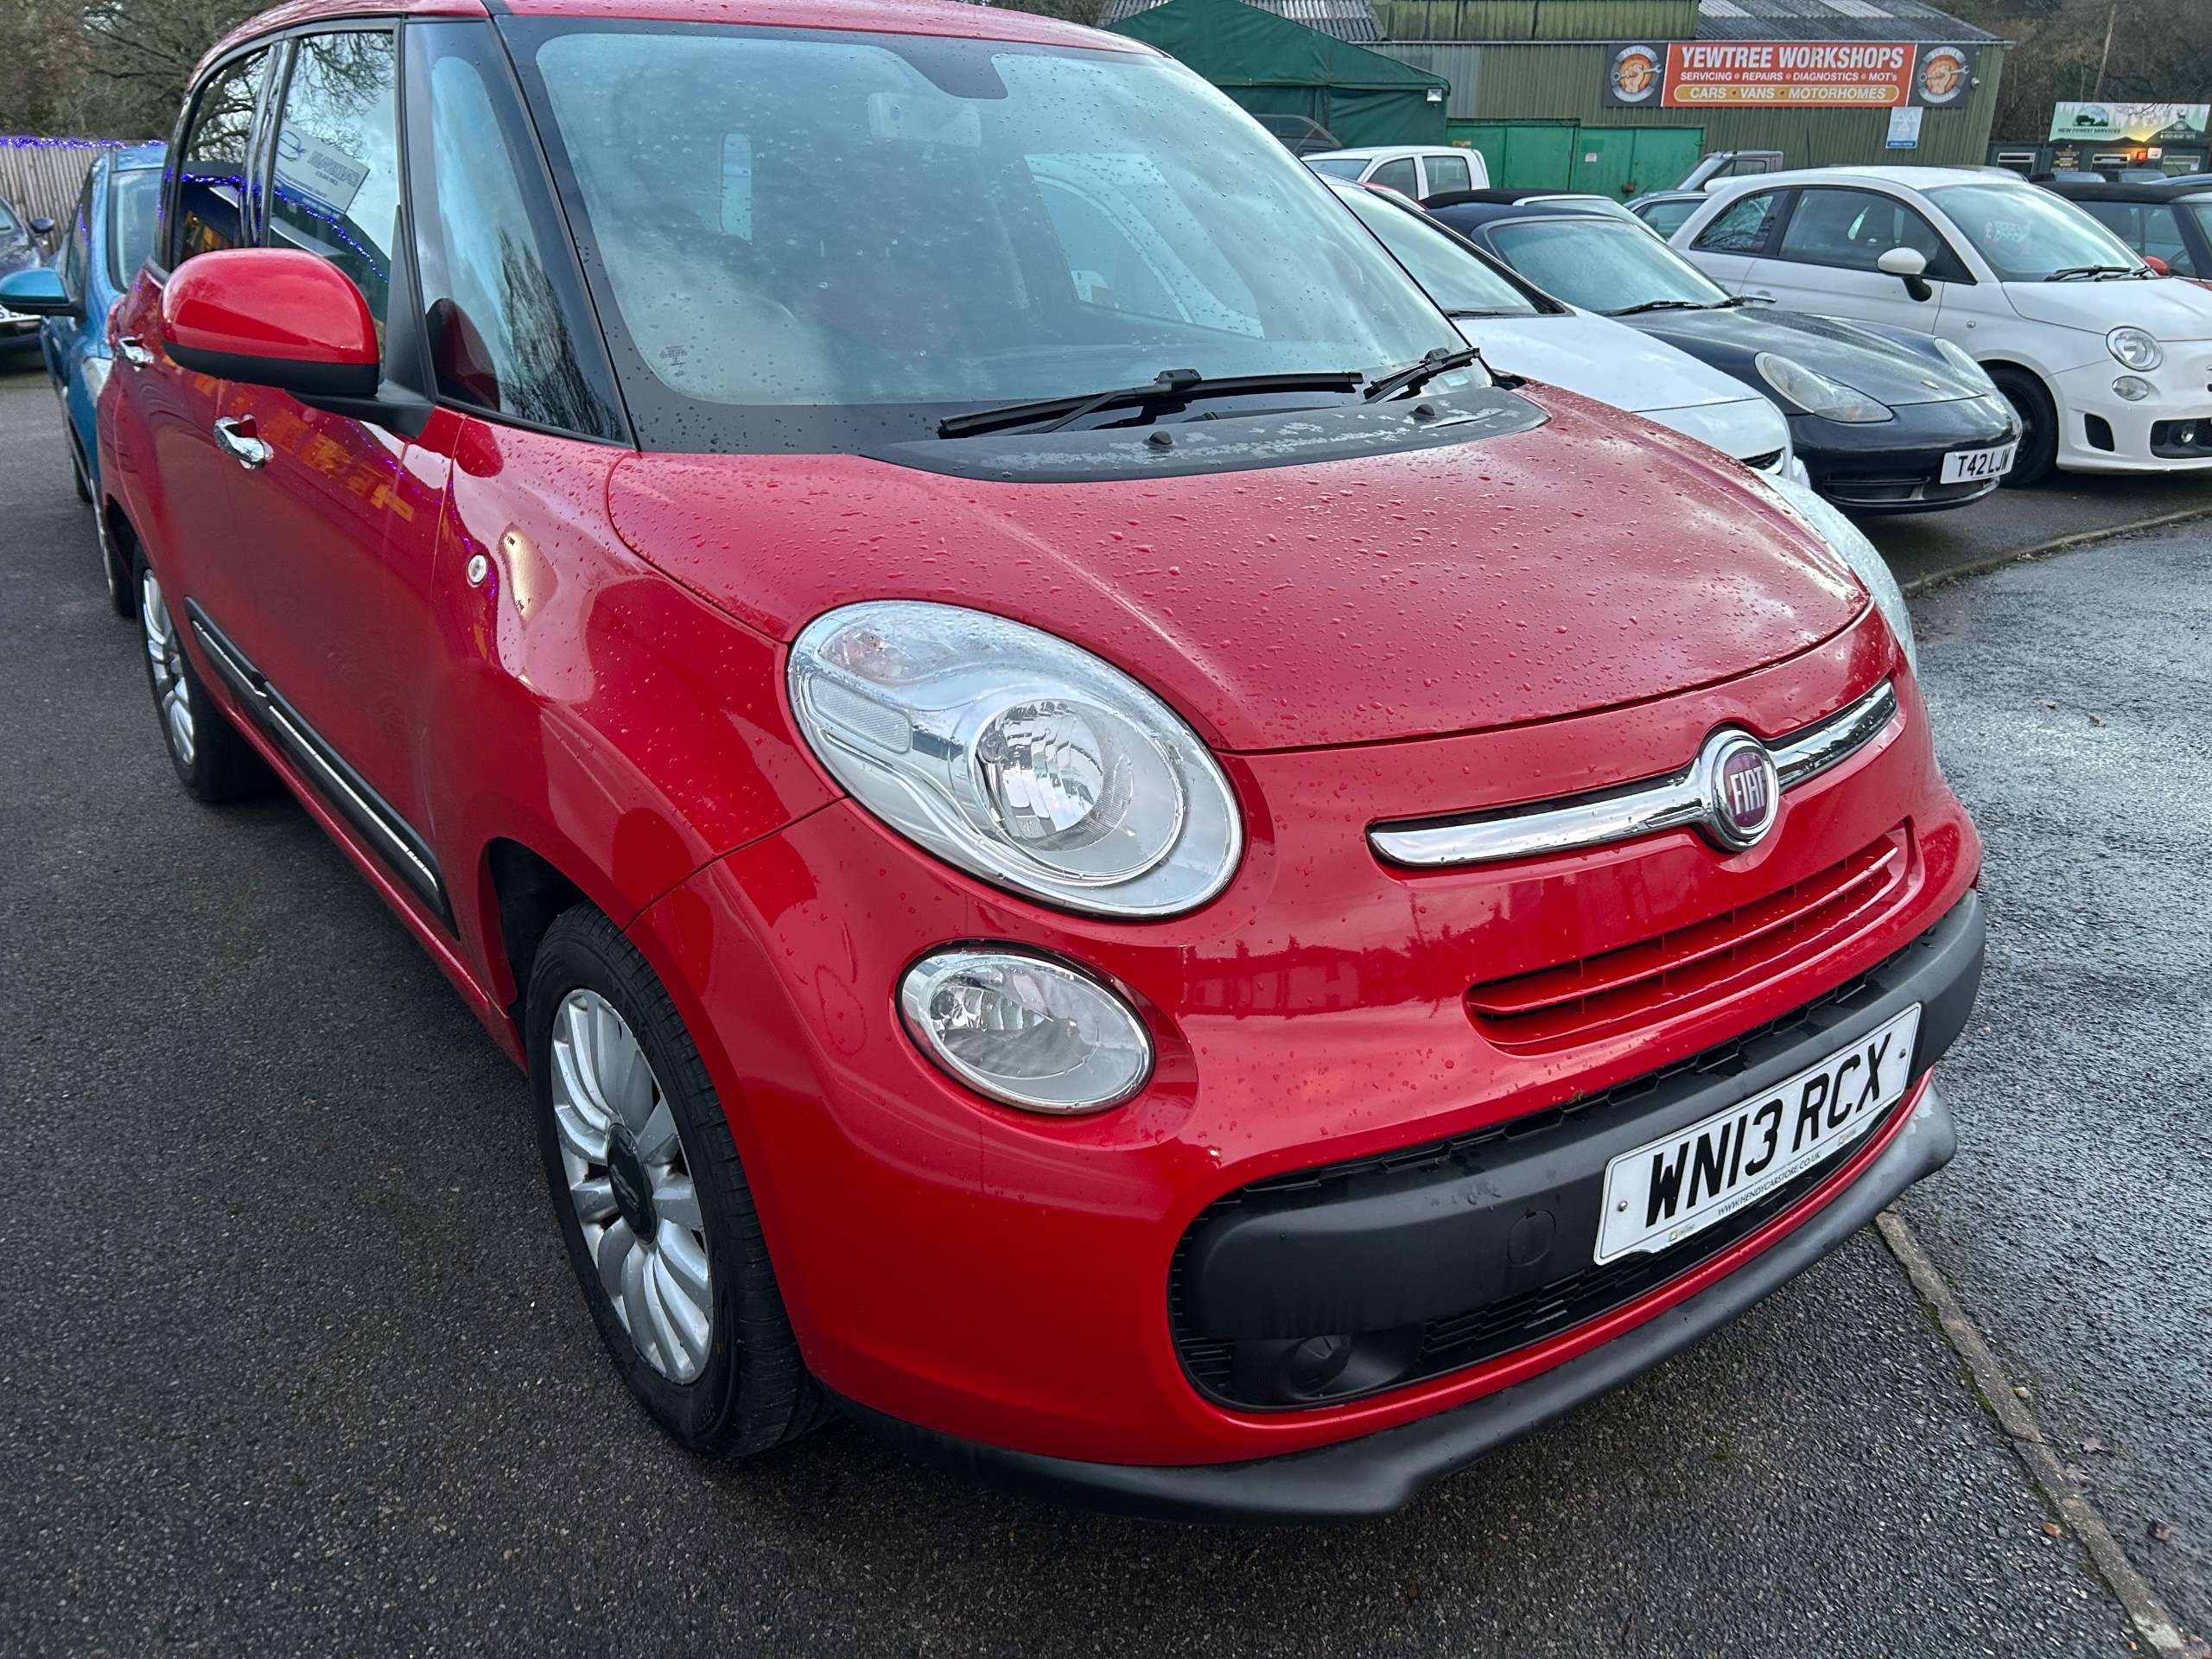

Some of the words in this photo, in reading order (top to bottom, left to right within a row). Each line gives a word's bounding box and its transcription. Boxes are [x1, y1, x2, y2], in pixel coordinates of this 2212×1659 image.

[1681, 47, 1773, 68] YEWTREE
[1779, 47, 1904, 69] WORKSHOPS
[1680, 72, 1732, 81] SERVICING
[1741, 72, 1783, 81] REPAIRS
[1792, 72, 1859, 81] DIAGNOSTICS
[1868, 72, 1897, 82] MOT's
[1689, 86, 1726, 99] CARS
[1739, 86, 1776, 99] VANS
[1789, 86, 1886, 99] MOTORHOMES
[1958, 454, 1987, 477] T42
[1729, 766, 1765, 816] FIAT
[1644, 1098, 1783, 1229] WN13
[1791, 1031, 1892, 1154] RCX
